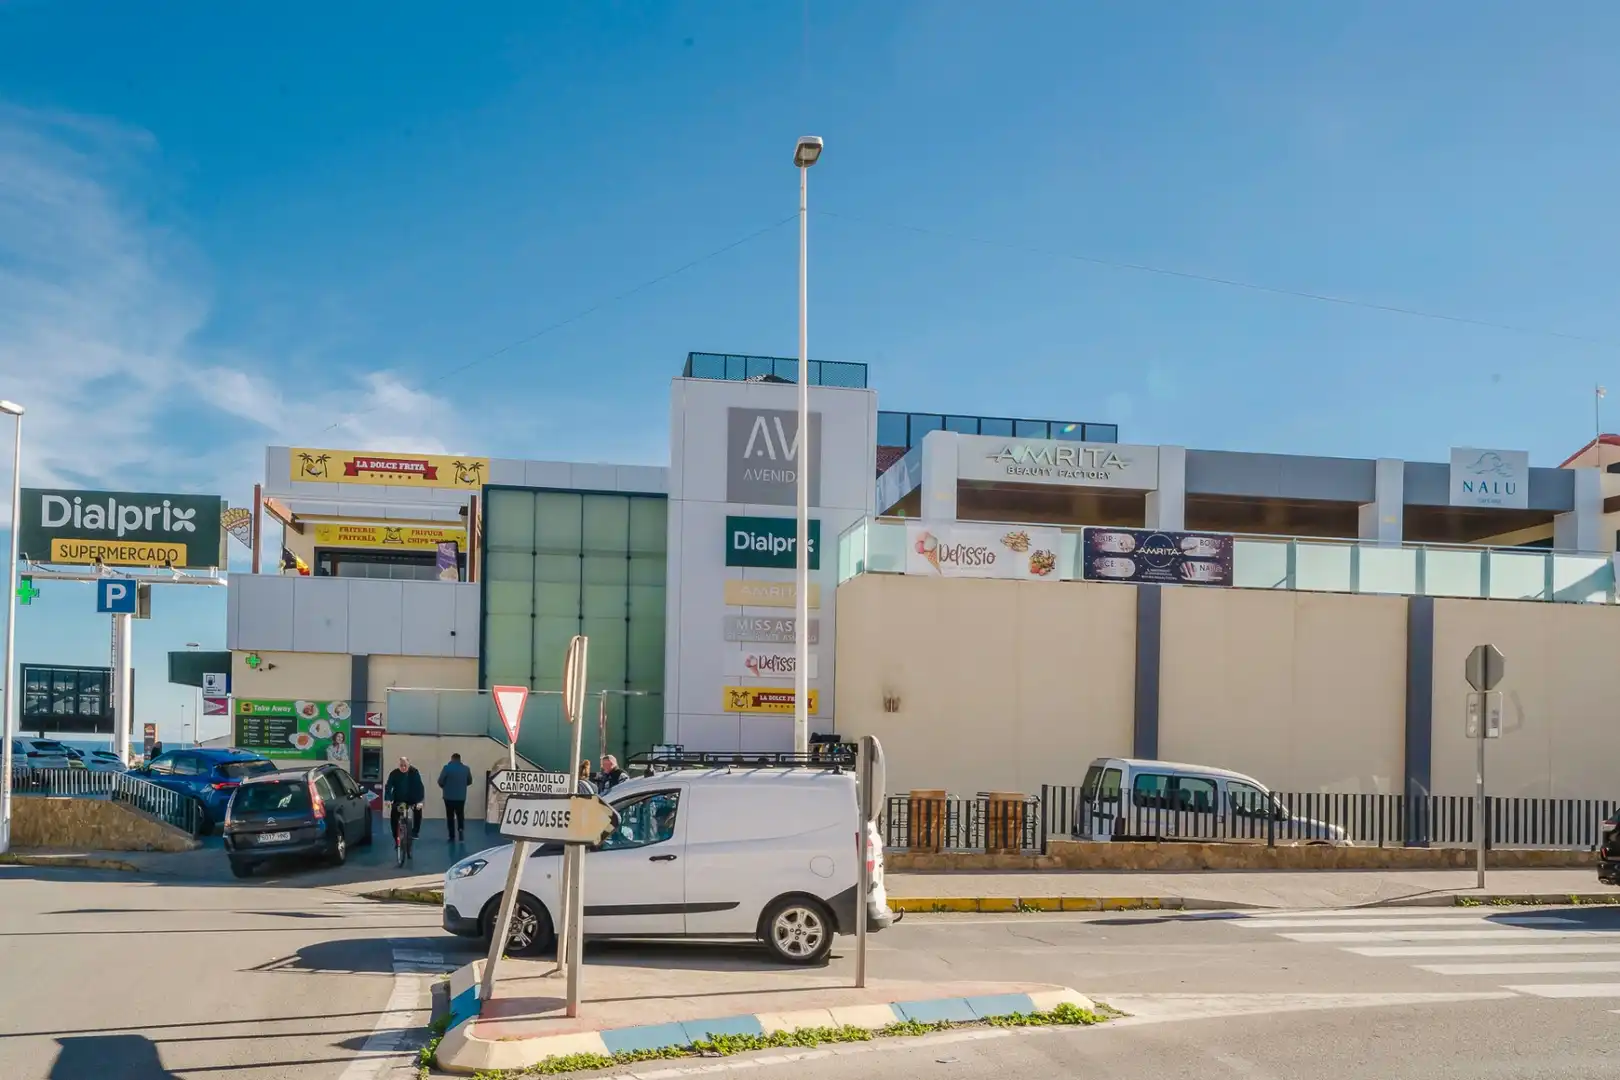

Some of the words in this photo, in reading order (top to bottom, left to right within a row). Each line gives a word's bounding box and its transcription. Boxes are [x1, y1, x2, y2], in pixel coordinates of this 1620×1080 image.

[986, 443, 1130, 470] AMRITA
[370, 462, 397, 470] DOLCE
[399, 463, 426, 471] FRITA
[1006, 465, 1053, 477] BEAUTY
[1058, 470, 1111, 480] FACTORY
[743, 468, 799, 483] AVENID
[1462, 480, 1516, 495] NALU
[41, 494, 196, 537] Dialprix
[734, 531, 814, 556] Dialprx
[60, 544, 179, 561] SUPERMERCADO
[1135, 547, 1182, 556] AMRITA
[106, 583, 127, 609] P
[737, 619, 771, 631] MISS
[506, 772, 565, 784] MERCADILLO
[506, 809, 529, 826] LOS
[533, 810, 570, 828] DOLSES
